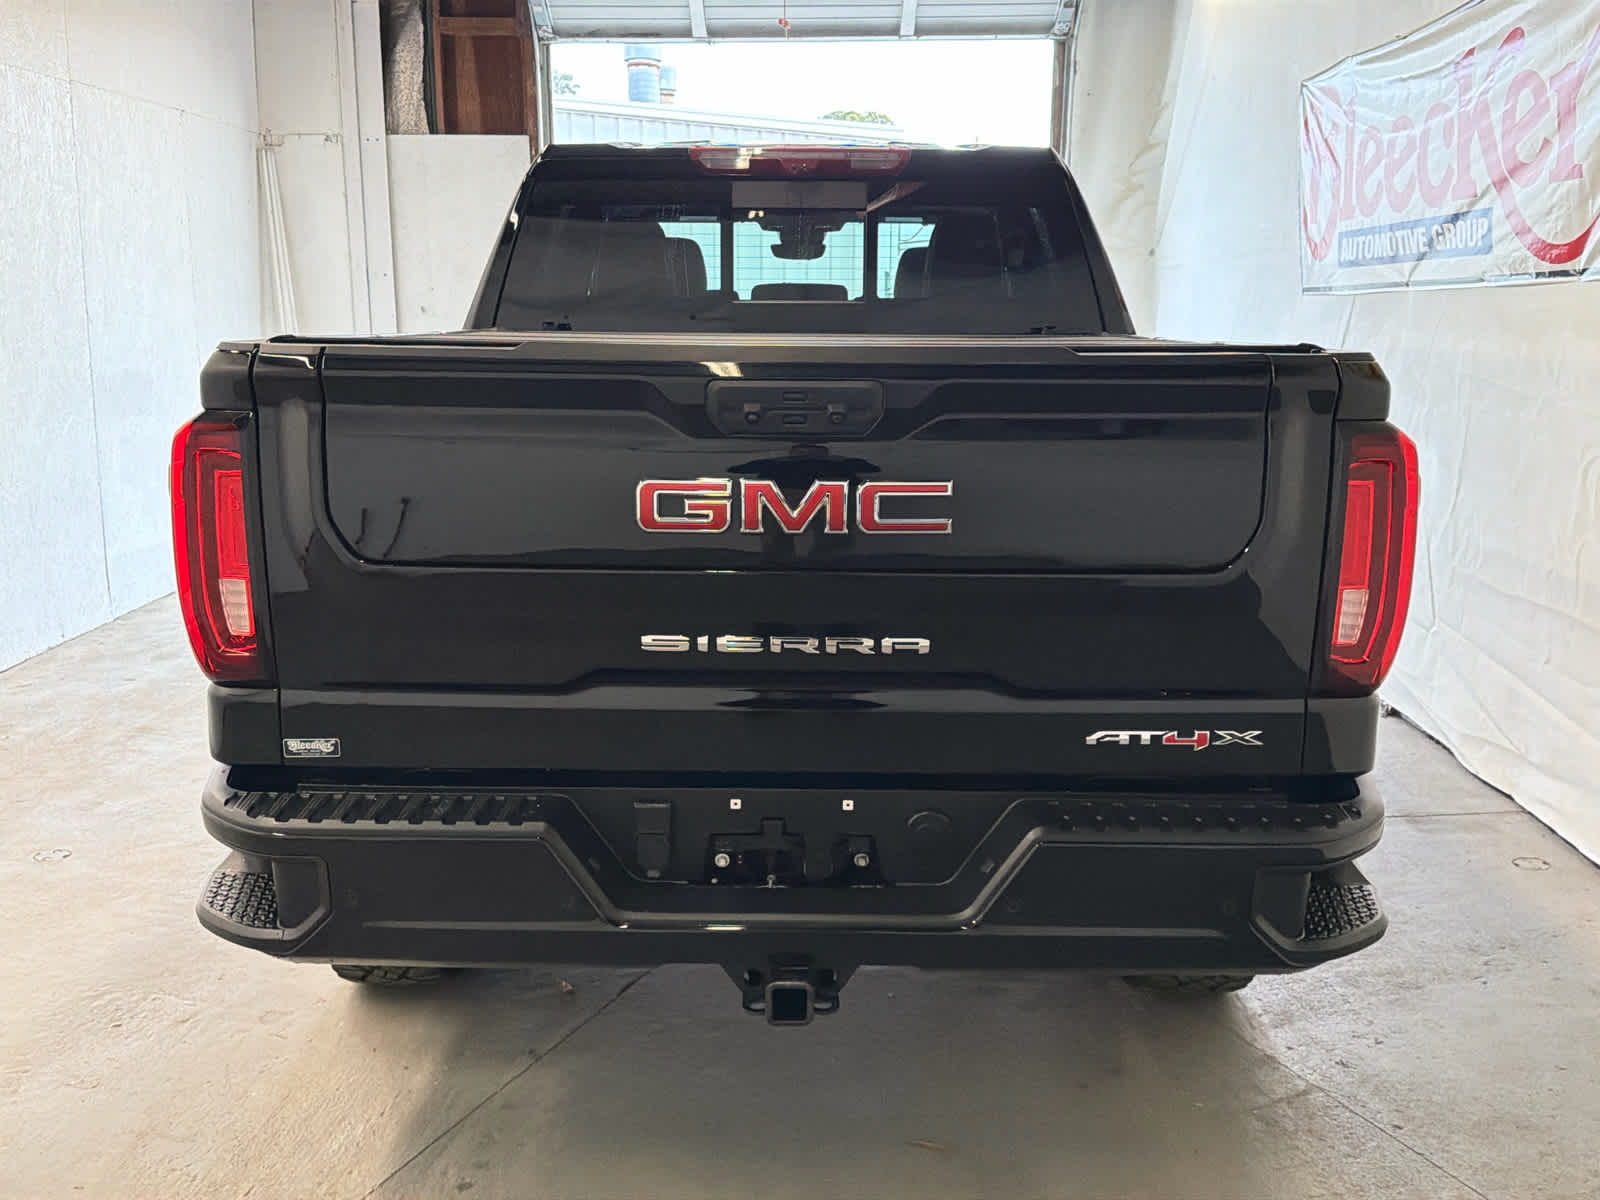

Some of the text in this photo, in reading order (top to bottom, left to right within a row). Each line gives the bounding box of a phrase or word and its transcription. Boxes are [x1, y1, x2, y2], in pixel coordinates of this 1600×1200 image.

[1340, 217, 1489, 261] AUTOMOTIVE GROUP
[636, 478, 953, 534] GMC
[640, 634, 931, 655] SIERRA
[1085, 730, 1265, 751] AT4X
